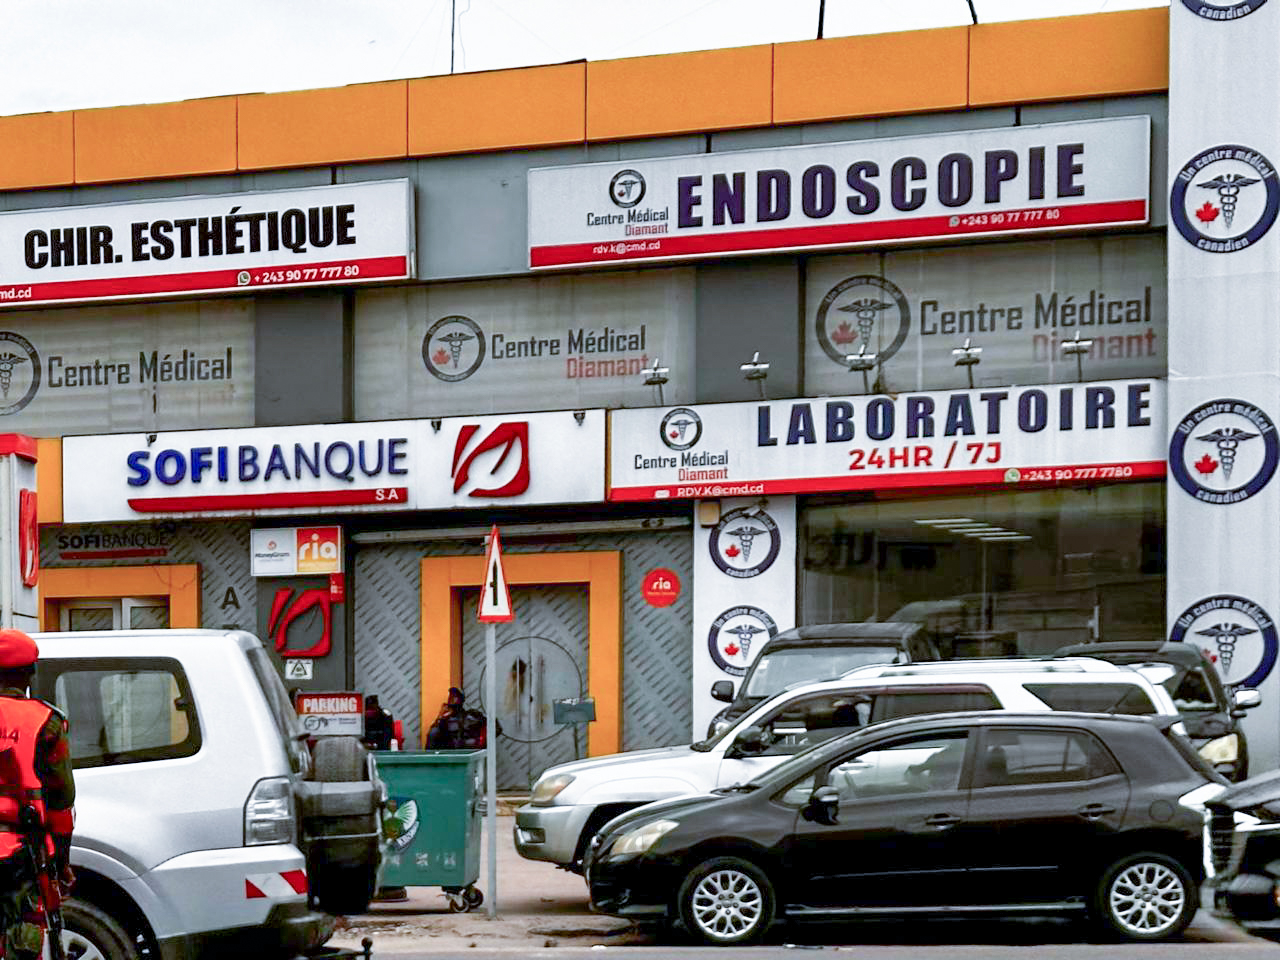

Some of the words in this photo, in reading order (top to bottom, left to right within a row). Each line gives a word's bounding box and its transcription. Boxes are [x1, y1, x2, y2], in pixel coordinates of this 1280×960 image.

[1199, 5, 1251, 20] canadien
[1179, 165, 1197, 182] Un
[1197, 149, 1233, 168] centre
[1234, 149, 1273, 178] médical
[677, 142, 1085, 228] ENDOSCOPIE
[587, 212, 624, 226] Centre
[627, 206, 669, 222] Médical
[991, 213, 1004, 224] 90
[1007, 212, 1020, 222] 77
[1023, 210, 1043, 221] 777
[24, 225, 123, 269] CHIR.
[131, 204, 357, 262] ESTHÉTIQUE
[625, 223, 669, 237] Diamant
[592, 241, 661, 255] rdv.k@cmd.cd
[1197, 238, 1249, 252] canadien
[286, 270, 301, 282] 90
[303, 268, 318, 280] 77
[320, 266, 342, 279] 777
[344, 265, 359, 277] 80
[920, 300, 1023, 336] Centre
[1035, 286, 1152, 329] Médical
[491, 333, 561, 360] Centre
[567, 324, 647, 355] Médical
[48, 355, 130, 388] Centre
[139, 347, 233, 383] Médical
[756, 383, 1152, 447] LABORATOIRE
[1178, 418, 1195, 435] Un
[1194, 403, 1231, 423] centre
[1233, 403, 1273, 432] médical
[126, 437, 409, 487] SOFIBANQUE
[634, 454, 677, 470] Centre
[681, 450, 729, 468] Médical
[848, 445, 933, 471] 24HR
[944, 441, 959, 469] /
[966, 441, 1002, 465] 7J
[678, 467, 729, 482] Diamant
[1055, 469, 1072, 480] 90
[1074, 468, 1098, 479] 777
[677, 484, 764, 497] RDV.K@cmd.cd
[1195, 488, 1249, 503] canadien
[57, 532, 169, 549] SOFIBANQUE
[299, 533, 337, 560] ria
[652, 576, 671, 590] ria
[1177, 613, 1194, 629] Un
[1192, 600, 1231, 619] centre
[1233, 599, 1272, 628] médical
[303, 697, 358, 714] PARKING
